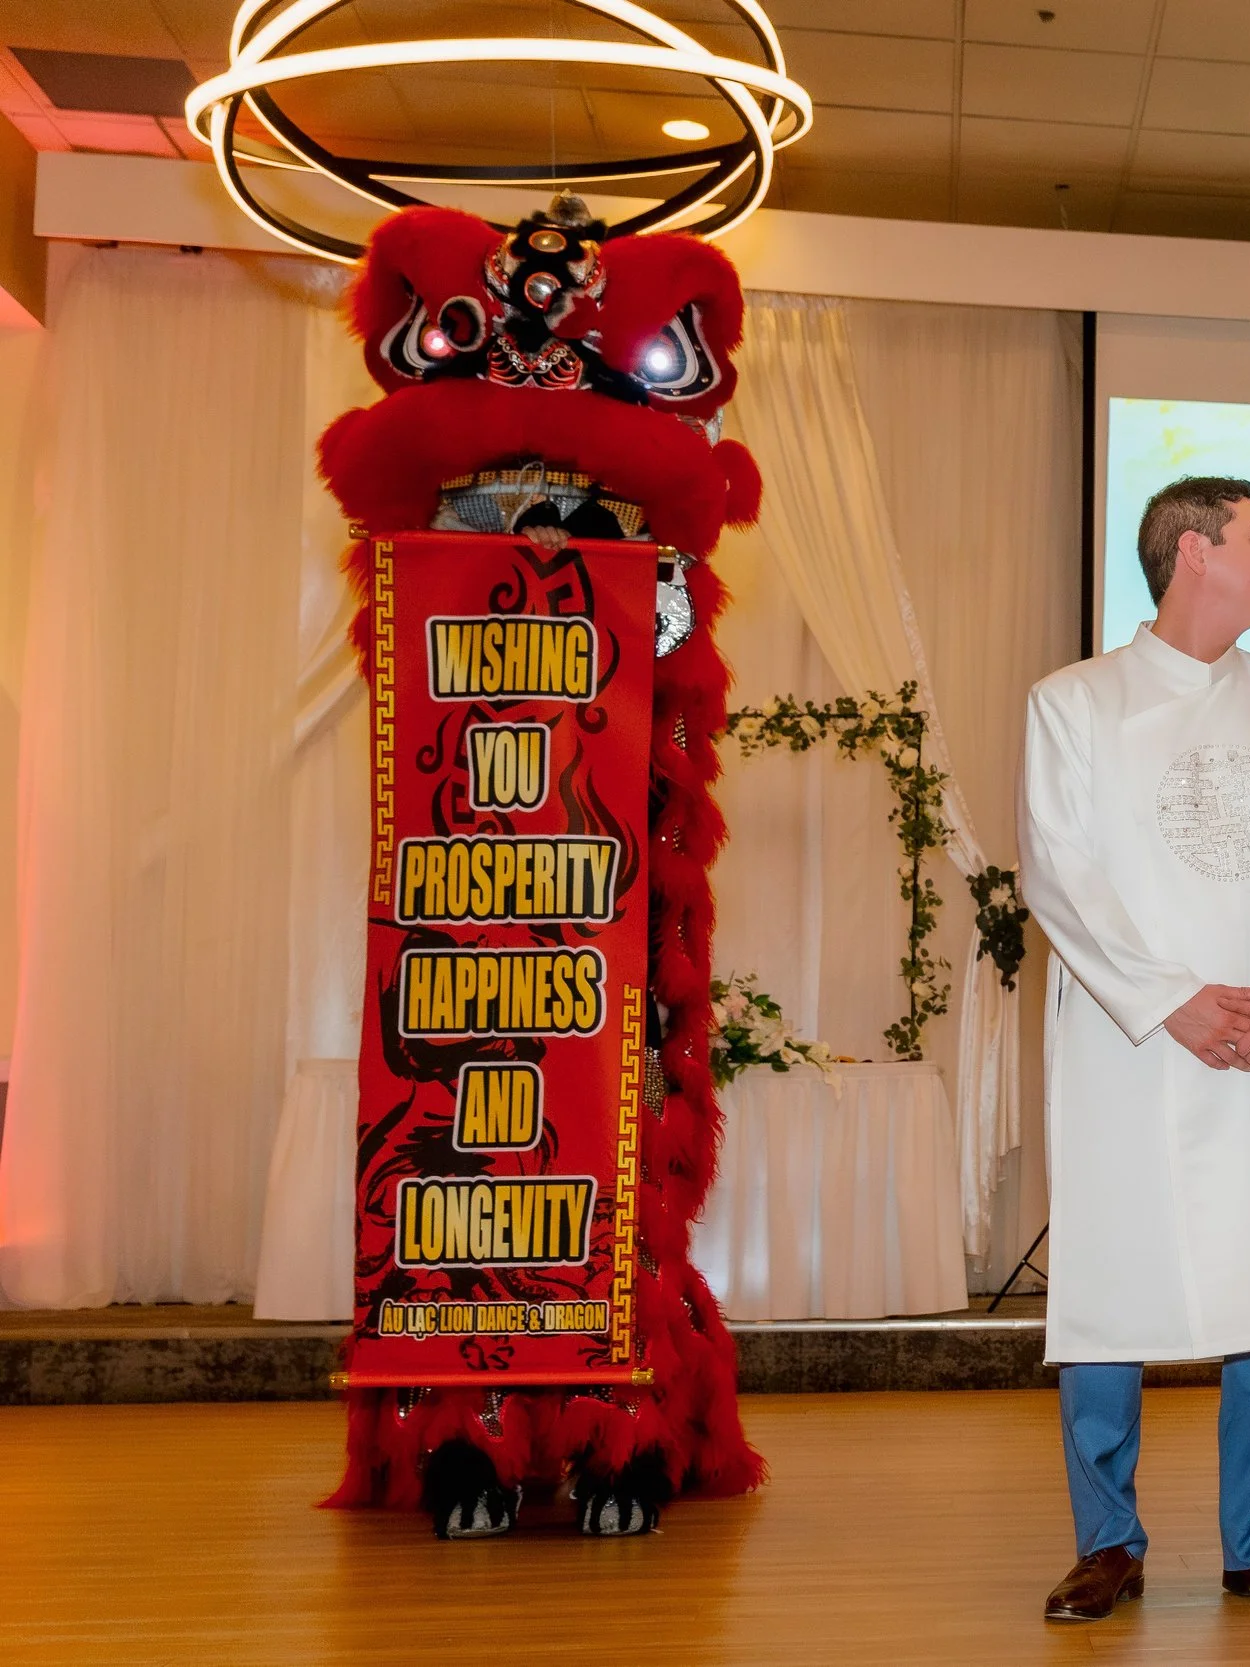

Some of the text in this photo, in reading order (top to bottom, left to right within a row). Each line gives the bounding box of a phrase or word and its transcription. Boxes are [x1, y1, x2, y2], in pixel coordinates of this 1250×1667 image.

[431, 619, 593, 699] WISHING
[470, 727, 545, 808] YOU
[400, 838, 615, 921] PROSPERITY
[404, 951, 601, 1034] HAPPINESS
[458, 1066, 539, 1148] AND
[401, 1179, 593, 1265] LONGEVITY
[439, 1304, 474, 1333] LION
[476, 1303, 526, 1332] DANCE
[528, 1306, 541, 1332] &
[543, 1302, 606, 1331] DRAGON
